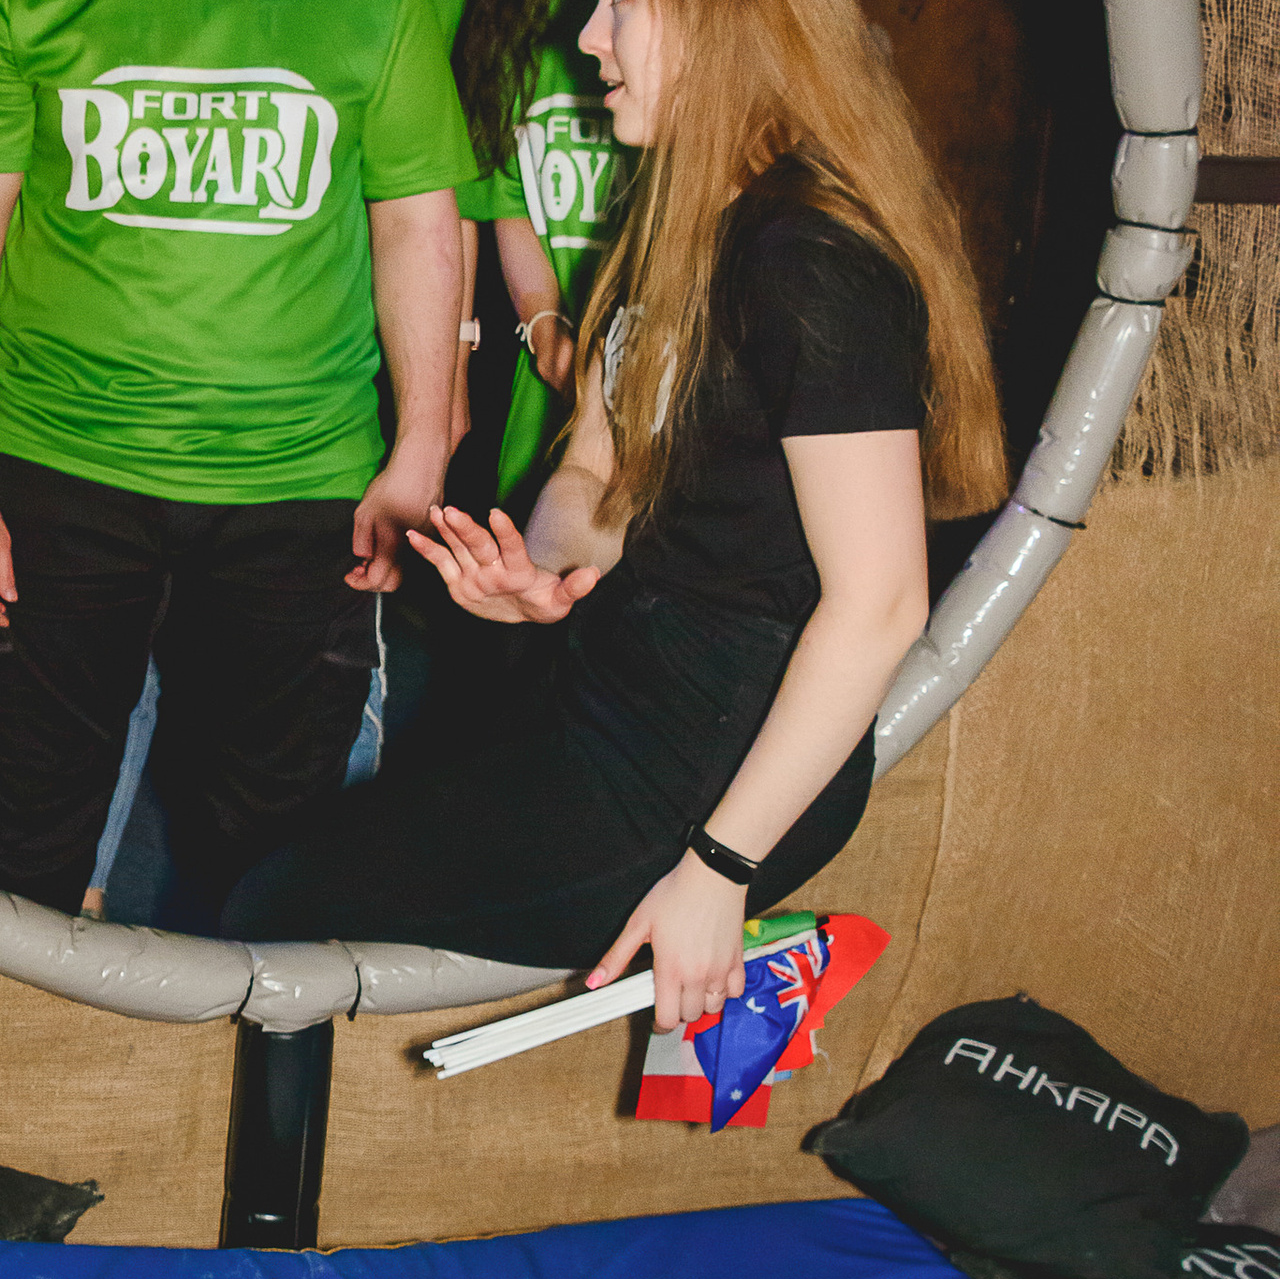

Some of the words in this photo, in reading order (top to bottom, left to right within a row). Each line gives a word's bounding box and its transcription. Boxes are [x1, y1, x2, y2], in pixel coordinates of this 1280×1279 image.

[57, 88, 339, 221] BOYARD
[131, 89, 268, 121] FORT
[943, 1037, 1181, 1167] АНКАРА
